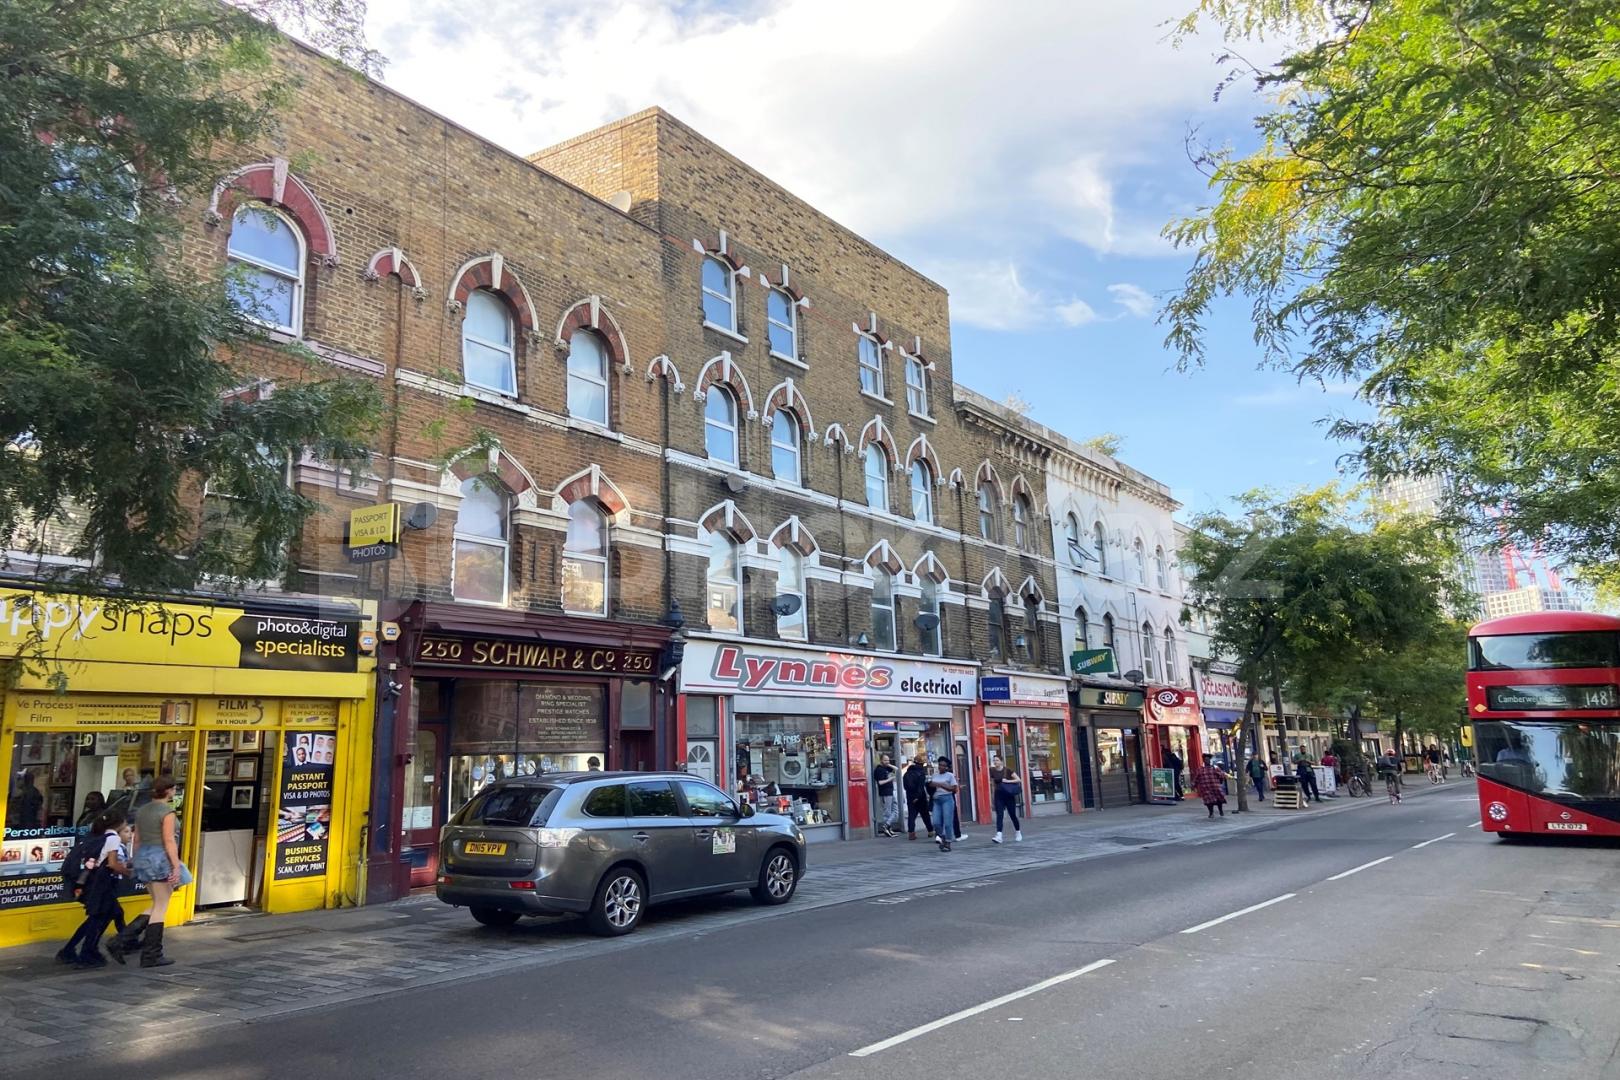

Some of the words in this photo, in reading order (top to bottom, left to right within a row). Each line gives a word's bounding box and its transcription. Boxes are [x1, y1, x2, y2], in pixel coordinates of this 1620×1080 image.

[354, 512, 387, 524] PASSPORT
[352, 545, 386, 558] PHOTOS
[257, 618, 347, 638] photo&digital
[255, 640, 345, 657] specialists
[421, 641, 462, 658] 250
[472, 641, 567, 669] SCHWAR
[572, 652, 584, 669] &
[623, 655, 652, 670] 250
[1077, 651, 1108, 671] SUBWAY
[715, 647, 892, 689] Lynnes
[901, 676, 962, 696] electrical
[1104, 691, 1128, 704] SUBWAY
[1586, 691, 1607, 706] 148
[33, 699, 74, 710] Process
[218, 699, 248, 710] FILM
[30, 713, 53, 723] Film
[291, 772, 326, 781] INSTANT
[287, 781, 329, 790] PASSPORT
[283, 792, 297, 800] VISA
[303, 791, 309, 799] ID
[309, 790, 331, 798] PHOTOS
[3, 825, 77, 838] Personalised
[284, 845, 322, 856] BUSINESS
[284, 854, 321, 865] SERVICES
[277, 866, 294, 875] SCAN,
[310, 862, 326, 870] PRINT
[0, 879, 29, 888] STANT
[29, 876, 64, 885] PHOTOS
[14, 886, 36, 895] YOUR
[37, 883, 65, 893] PHONE
[1, 895, 32, 904] DIGITAL
